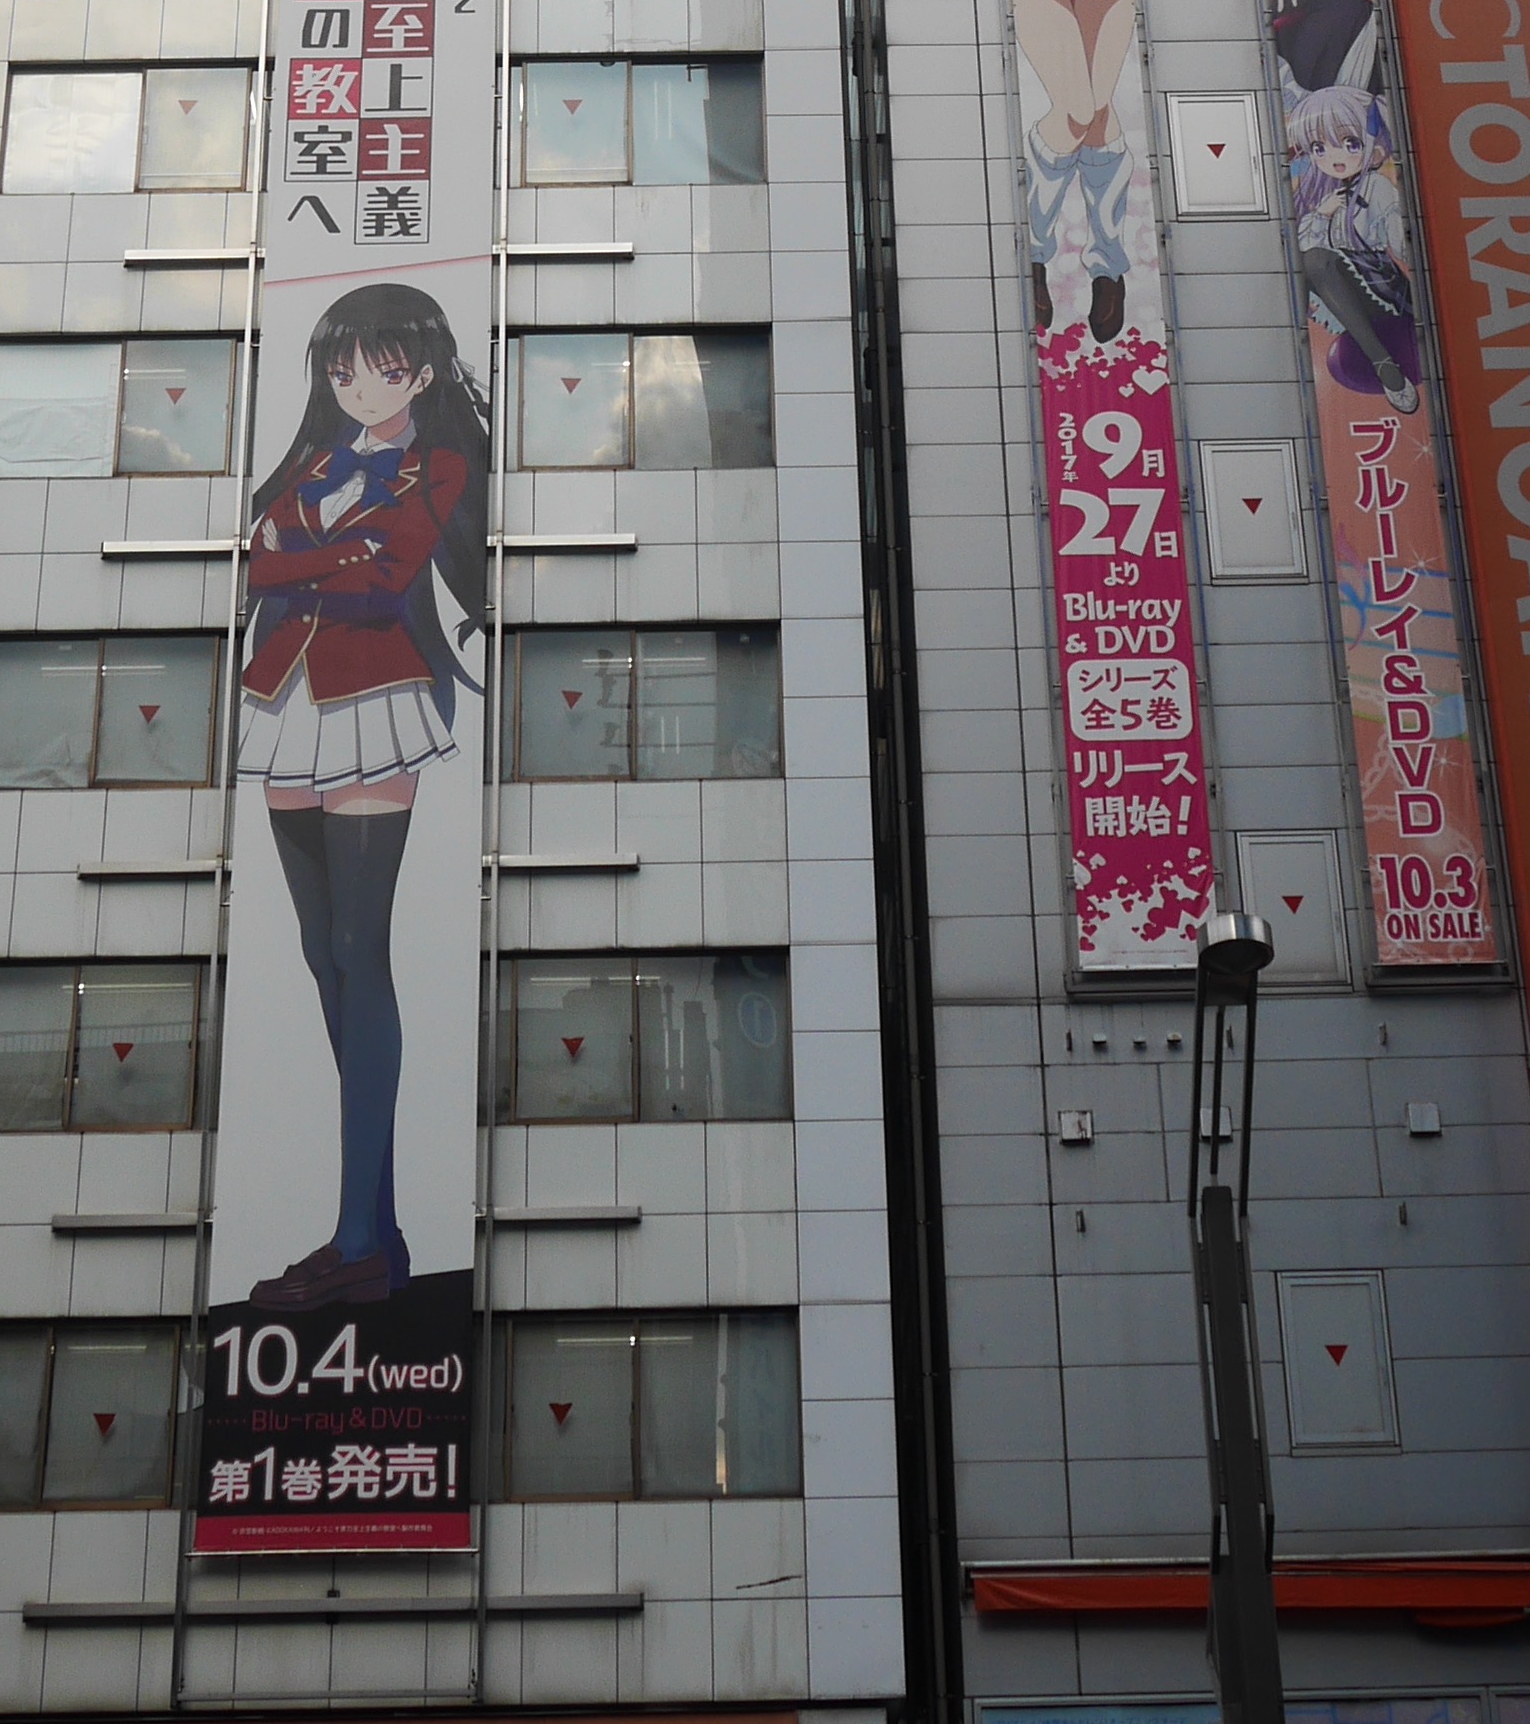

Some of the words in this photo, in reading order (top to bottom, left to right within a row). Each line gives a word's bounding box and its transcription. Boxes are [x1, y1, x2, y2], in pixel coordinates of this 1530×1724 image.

[287, 8, 359, 234] の教室へ
[1057, 412, 1079, 483] 2017年
[1082, 410, 1167, 480] 9月
[1058, 487, 1179, 559] 27日
[1103, 561, 1140, 586] より
[1062, 590, 1182, 628] Blu-ray
[1350, 417, 1447, 838] ブルーレイ&DVD
[1065, 633, 1087, 654] &
[1095, 625, 1176, 655] DVD
[1079, 664, 1179, 694] シリーズ
[1080, 696, 1182, 732] 全5巻
[1073, 748, 1198, 789] リリース
[1084, 794, 1192, 838] 開始!
[1377, 852, 1477, 912] 10.3
[1386, 910, 1422, 942] ON
[1429, 908, 1483, 940] SALE
[252, 1408, 346, 1433] Blu-ray
[349, 1408, 366, 1428] &
[371, 1407, 423, 1429] DVD
[209, 1442, 457, 1504] 第1巻発売!
